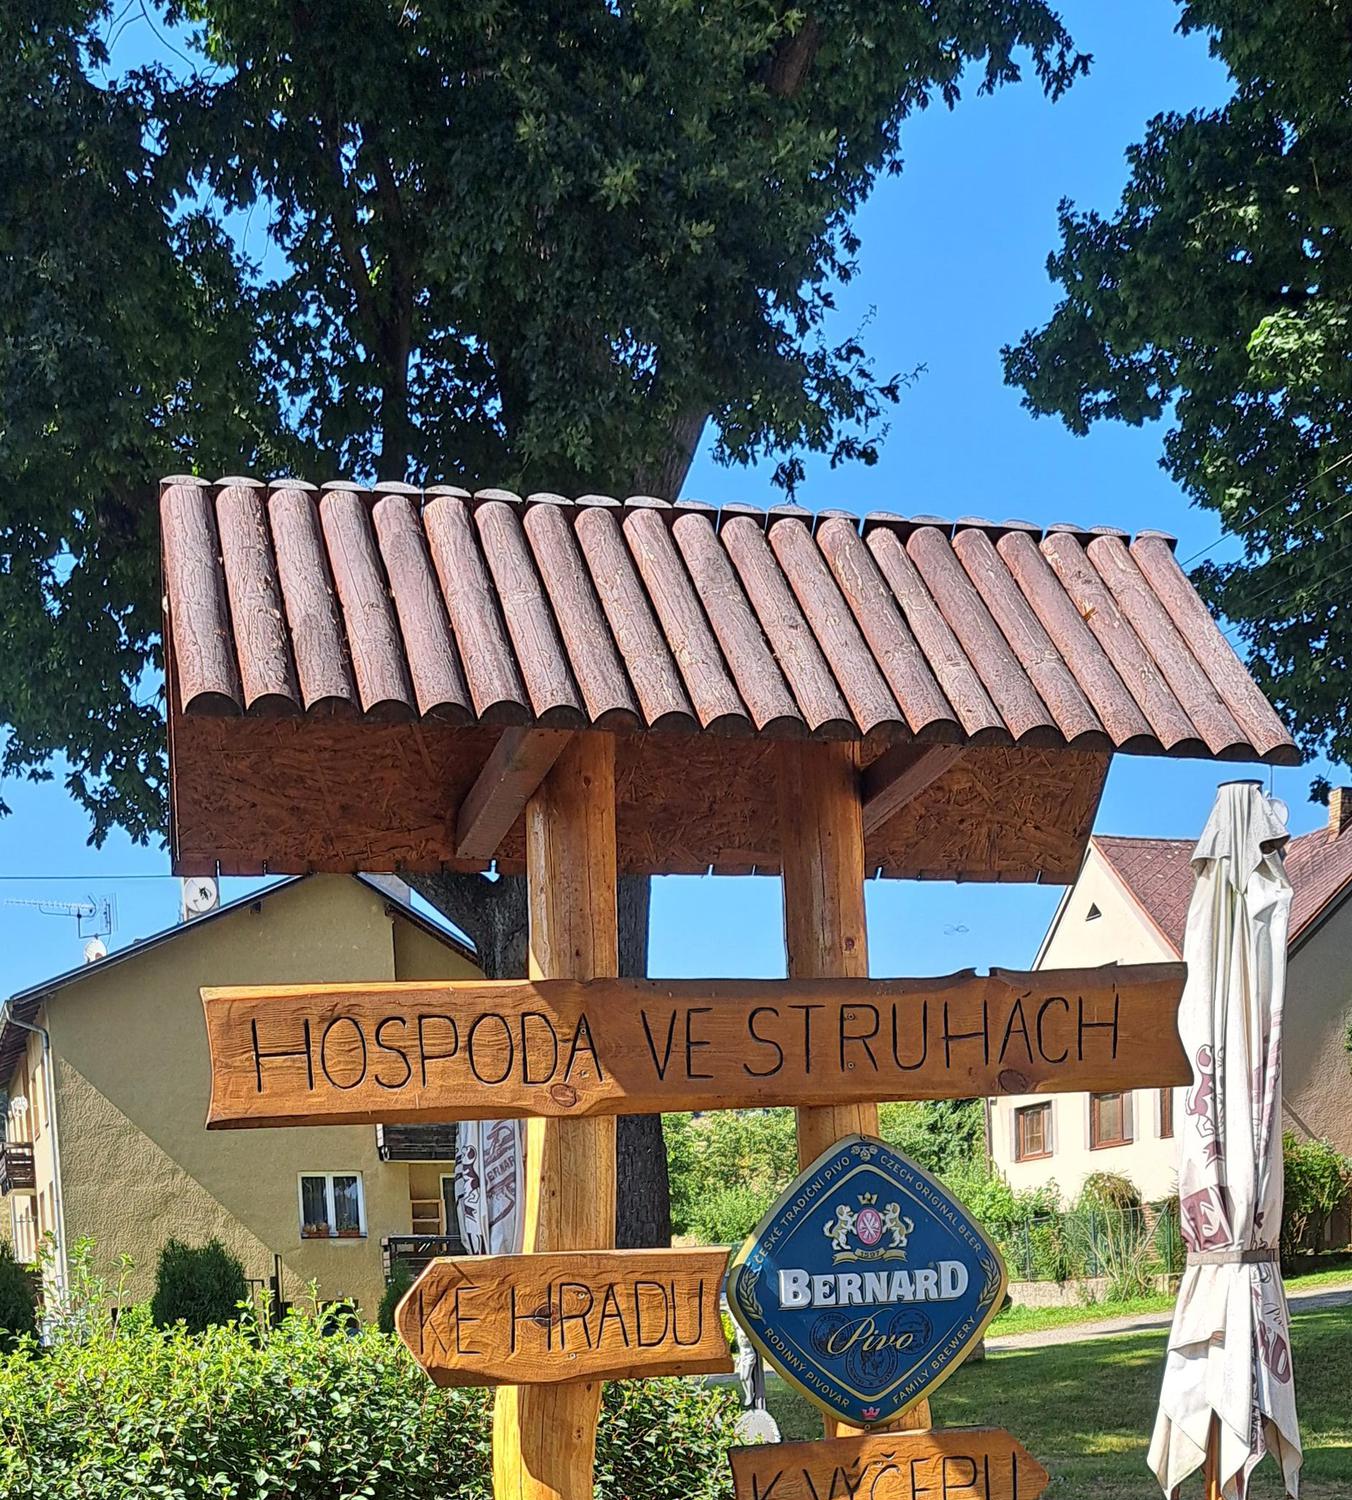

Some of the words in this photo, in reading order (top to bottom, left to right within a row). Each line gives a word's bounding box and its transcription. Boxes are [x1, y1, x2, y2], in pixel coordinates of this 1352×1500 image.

[250, 1011, 604, 1093] HOSPODA
[640, 1007, 714, 1082] VE
[743, 990, 1119, 1078] STRUHÁCH
[753, 1227, 783, 1265] ČESKÉ
[824, 1155, 850, 1182] PIVO
[879, 1155, 914, 1184] CZECH
[915, 1181, 957, 1226] ORIGINAL
[959, 1222, 982, 1252] BEER
[859, 1250, 881, 1258] 1597
[419, 1286, 481, 1355] KE
[510, 1279, 704, 1353] HRADU
[827, 1307, 913, 1355] Pivo
[804, 1371, 850, 1408] PIVOVAR
[892, 1370, 930, 1405] FAMILY
[931, 1315, 976, 1370] BREWERY
